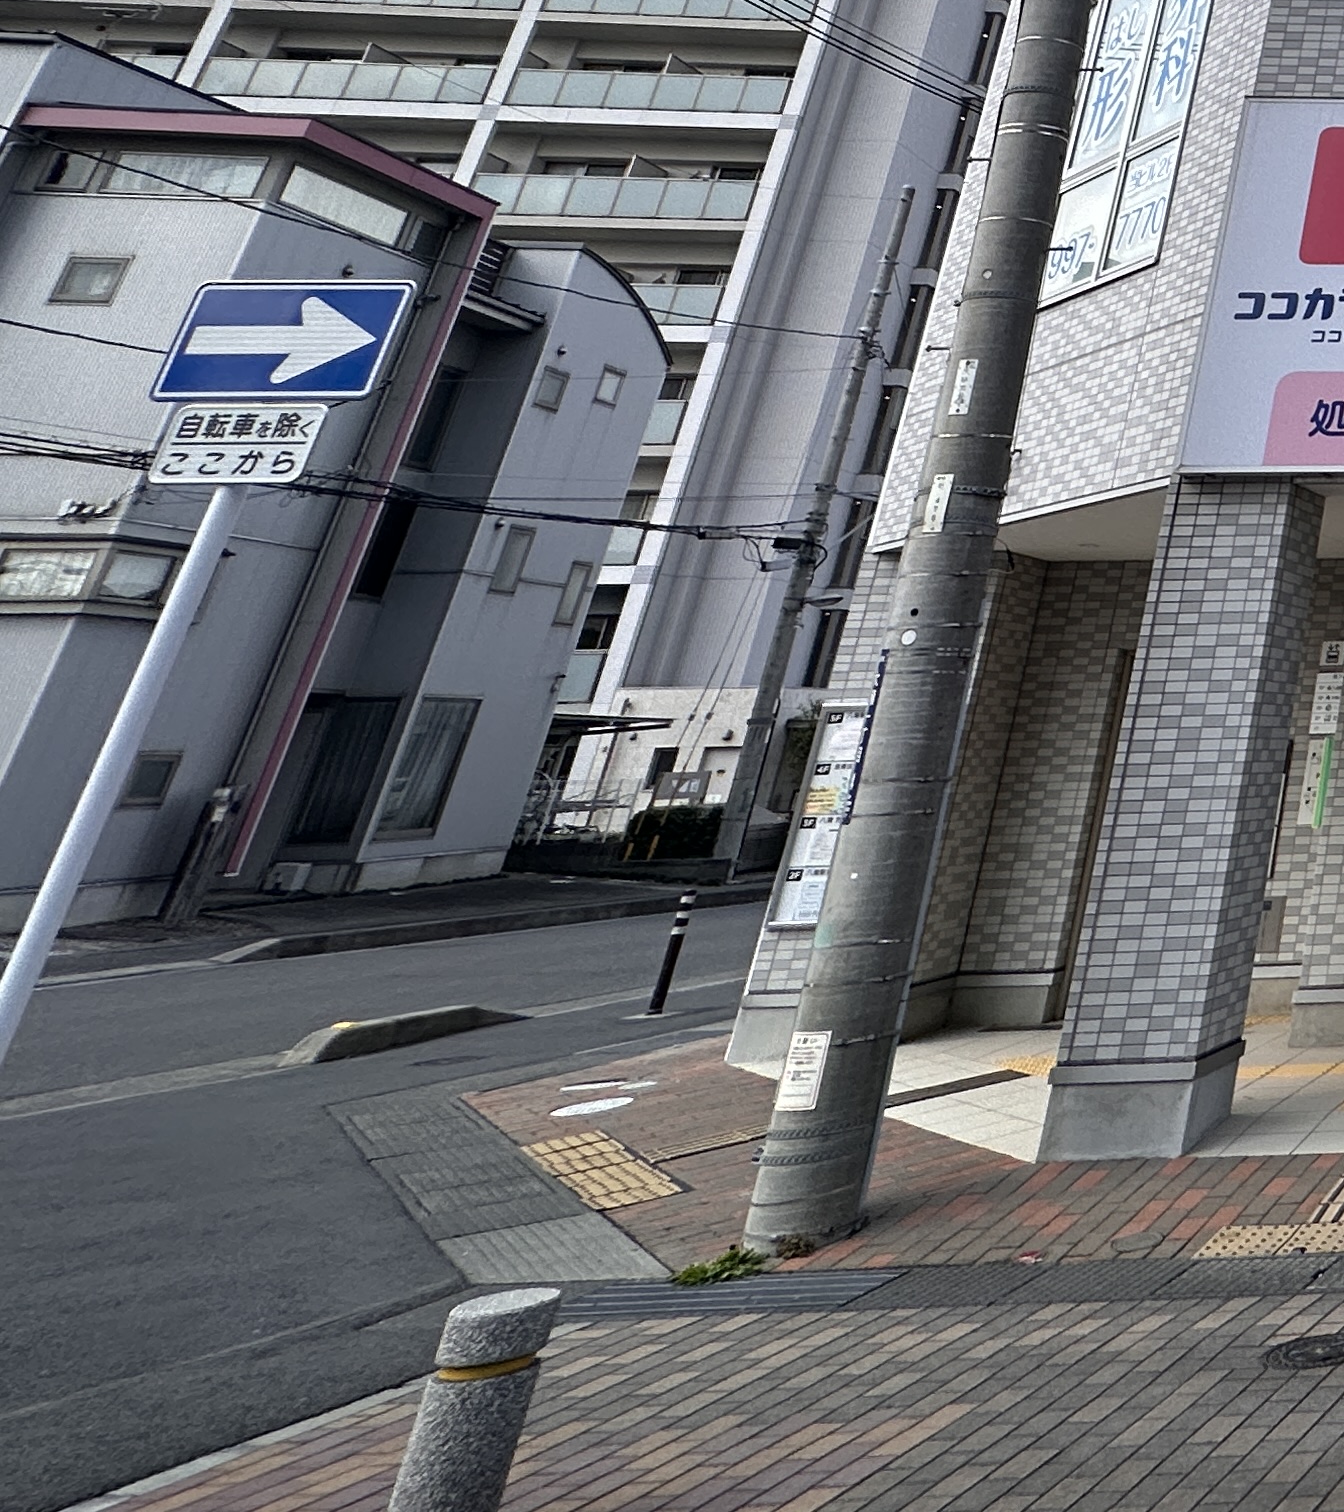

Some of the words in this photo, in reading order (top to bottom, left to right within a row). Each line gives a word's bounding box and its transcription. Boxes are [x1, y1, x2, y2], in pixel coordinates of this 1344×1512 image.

[176, 412, 317, 440] 自転車を除く
[160, 450, 296, 476] ここから
